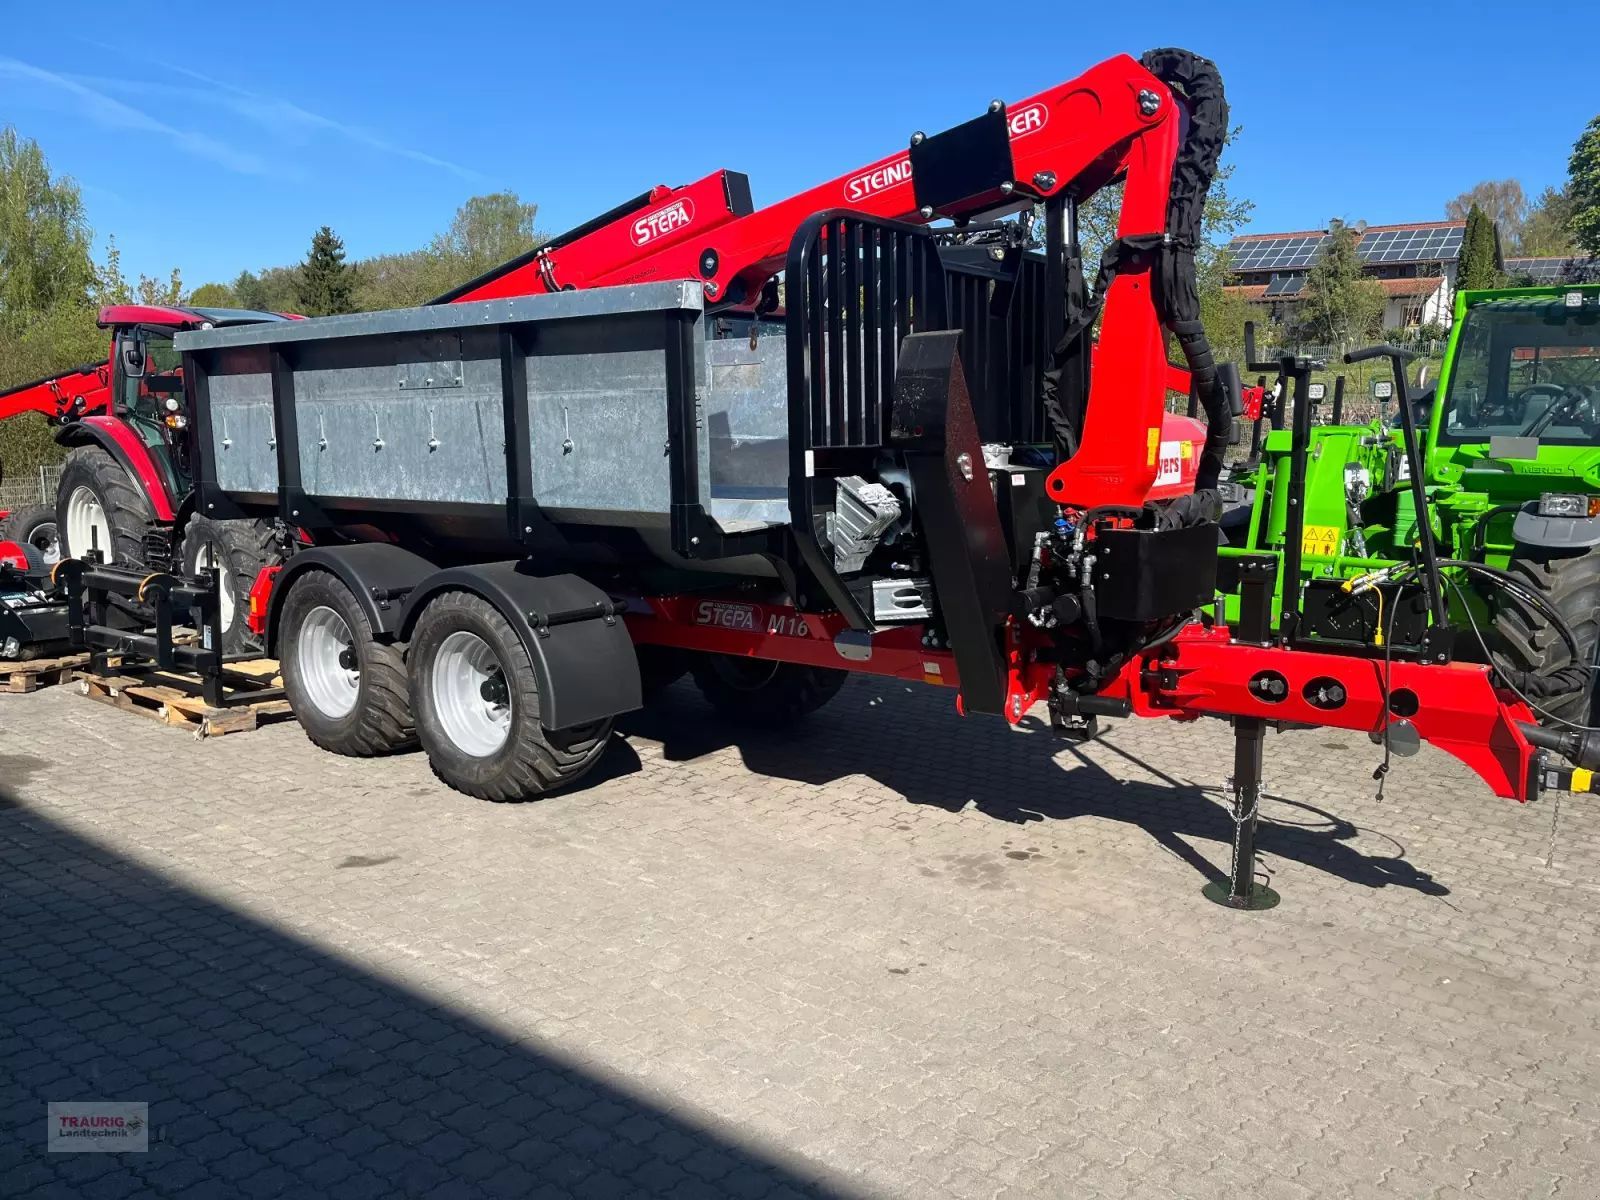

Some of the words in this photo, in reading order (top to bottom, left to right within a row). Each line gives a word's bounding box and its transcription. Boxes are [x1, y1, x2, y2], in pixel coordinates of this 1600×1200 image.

[1007, 108, 1041, 138] ER
[634, 206, 690, 245] STEPA
[1521, 465, 1563, 474] MERLO
[696, 602, 754, 630] STEPA
